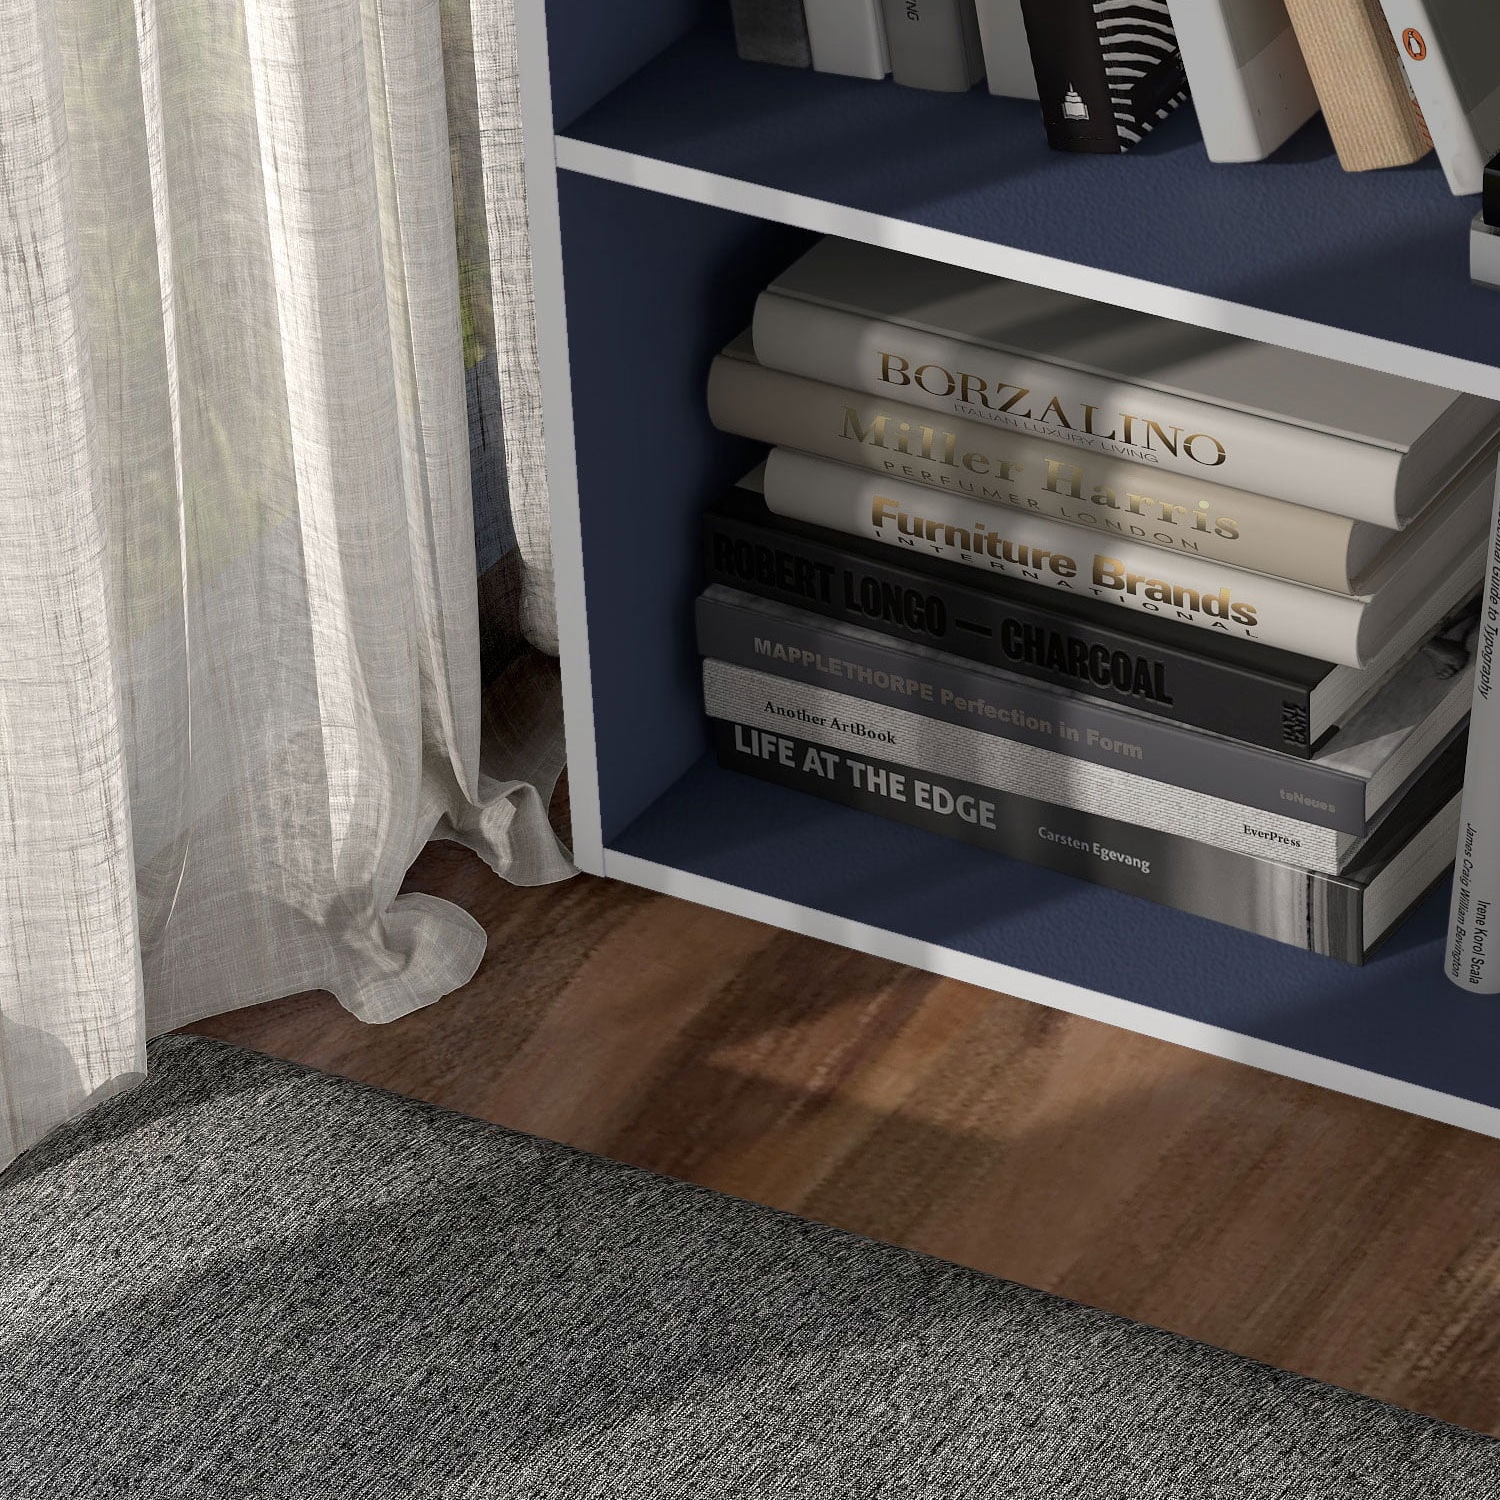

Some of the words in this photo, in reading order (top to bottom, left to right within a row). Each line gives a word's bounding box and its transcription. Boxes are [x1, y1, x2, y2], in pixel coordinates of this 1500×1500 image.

[876, 351, 1227, 467] BORZALINO
[953, 403, 1019, 427] ITALIAN
[1022, 419, 1095, 447] LUXURY
[1100, 442, 1160, 464] LIVING
[837, 404, 1024, 483] Miller
[1041, 458, 1240, 541] Harris
[883, 460, 1040, 510] PERFUMER
[1060, 507, 1200, 552] LONDON
[871, 495, 1077, 578] Furniture
[1092, 554, 1258, 627] Brands
[875, 530, 1259, 639] INTERNATIONAL
[711, 531, 835, 603] ROBERT
[842, 569, 948, 639] LONGO
[1000, 616, 1174, 706] CHARCOAL
[1488, 606, 1500, 621] to
[1477, 624, 1499, 700] Typography
[754, 636, 934, 702] MAPPLETHORPE
[940, 687, 1053, 735] Perfection
[1059, 720, 1080, 742] in
[1086, 728, 1144, 761] Form
[762, 701, 828, 728] Another
[829, 717, 897, 746] ArtBook
[734, 723, 797, 769] LIFE
[802, 746, 840, 781] AT
[846, 758, 907, 803] THE
[914, 779, 998, 831] EDGE
[1038, 825, 1091, 853] Carsten
[1092, 841, 1151, 875] Egevang
[1243, 823, 1302, 850] EverPress
[1466, 822, 1478, 853] James
[1459, 854, 1475, 887] Craig
[1456, 884, 1472, 926] William
[1476, 900, 1492, 925] Irene
[1473, 924, 1489, 953] Korol
[1469, 953, 1486, 985] Scala
